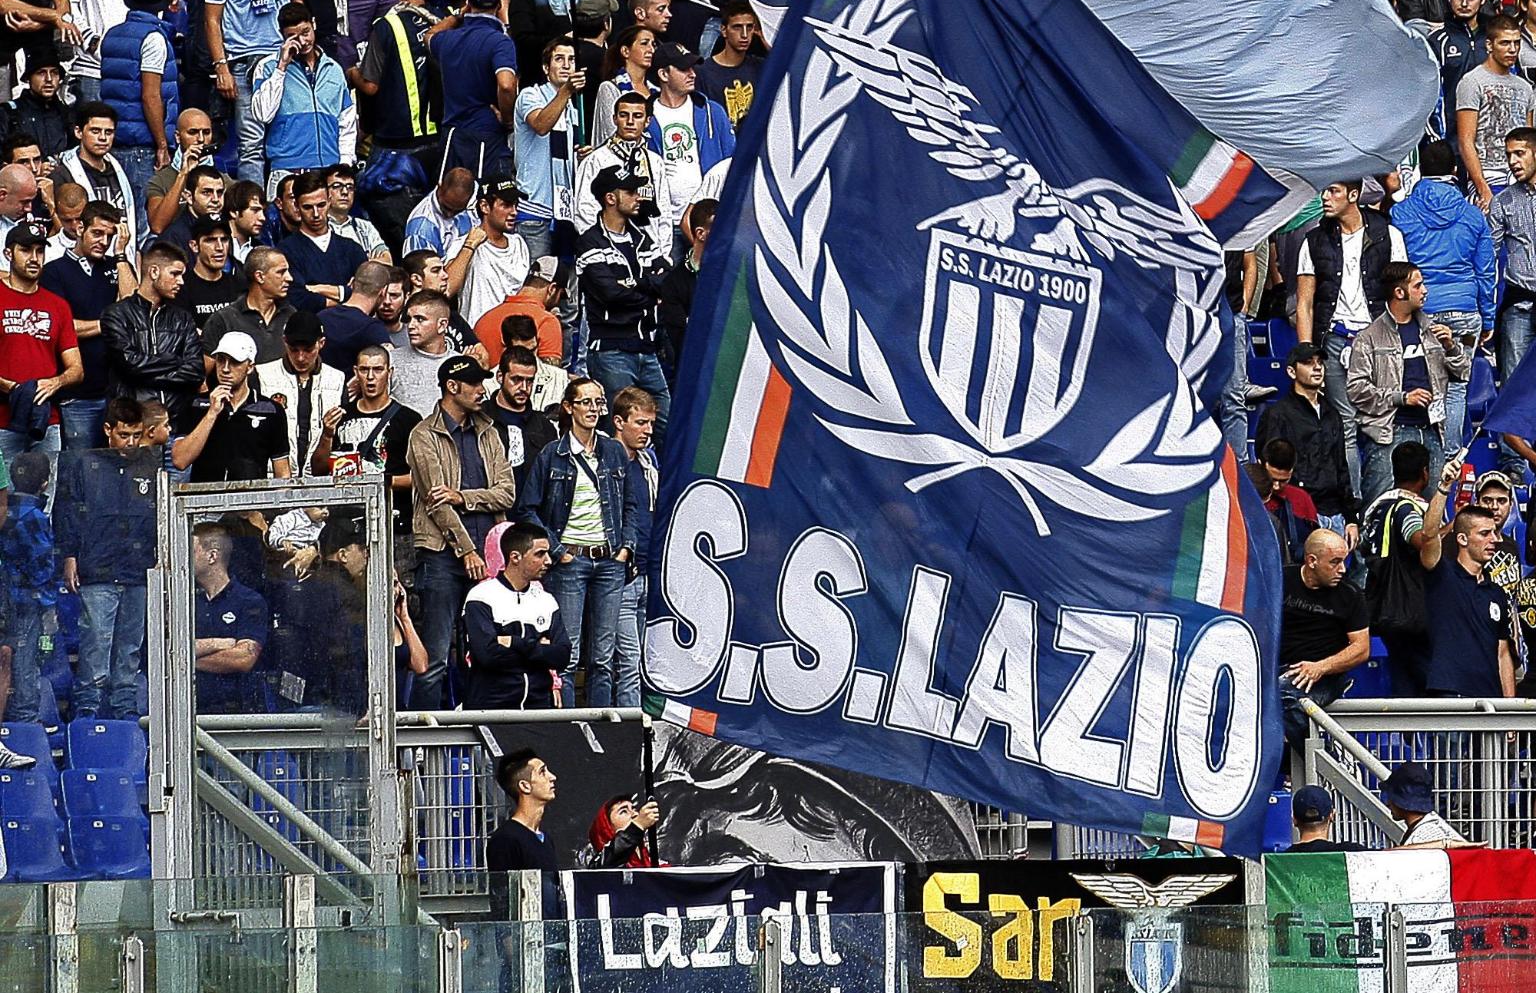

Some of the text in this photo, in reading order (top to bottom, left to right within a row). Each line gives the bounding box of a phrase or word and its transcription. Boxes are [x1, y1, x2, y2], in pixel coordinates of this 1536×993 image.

[940, 247, 1087, 305] S.S. LAZIO 1900
[597, 889, 842, 971] Laziali
[923, 872, 1082, 981] Sar
[1273, 911, 1530, 959] fidene
